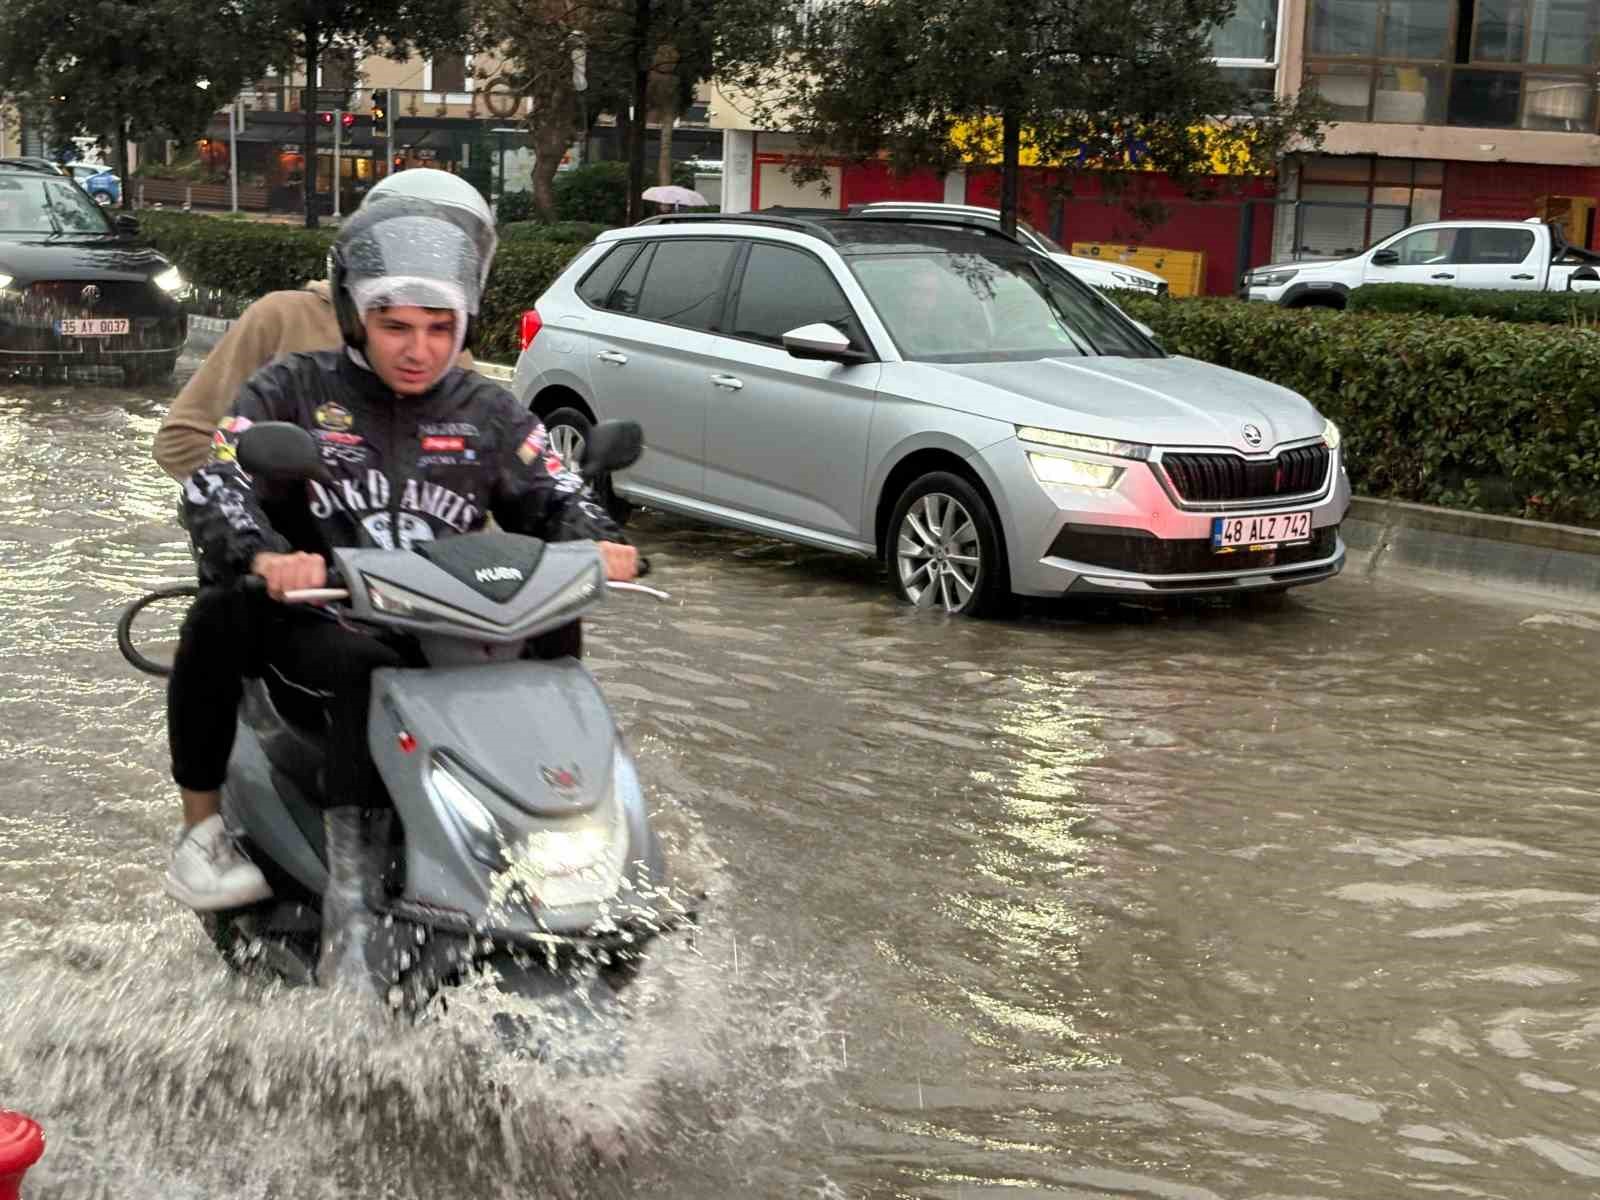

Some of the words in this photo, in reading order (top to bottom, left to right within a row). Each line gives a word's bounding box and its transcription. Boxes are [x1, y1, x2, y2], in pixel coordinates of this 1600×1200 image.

[63, 321, 76, 333] 35
[100, 321, 127, 333] 0037
[1224, 520, 1243, 542] 48
[1249, 517, 1276, 541] ALZ
[1281, 514, 1307, 538] 742
